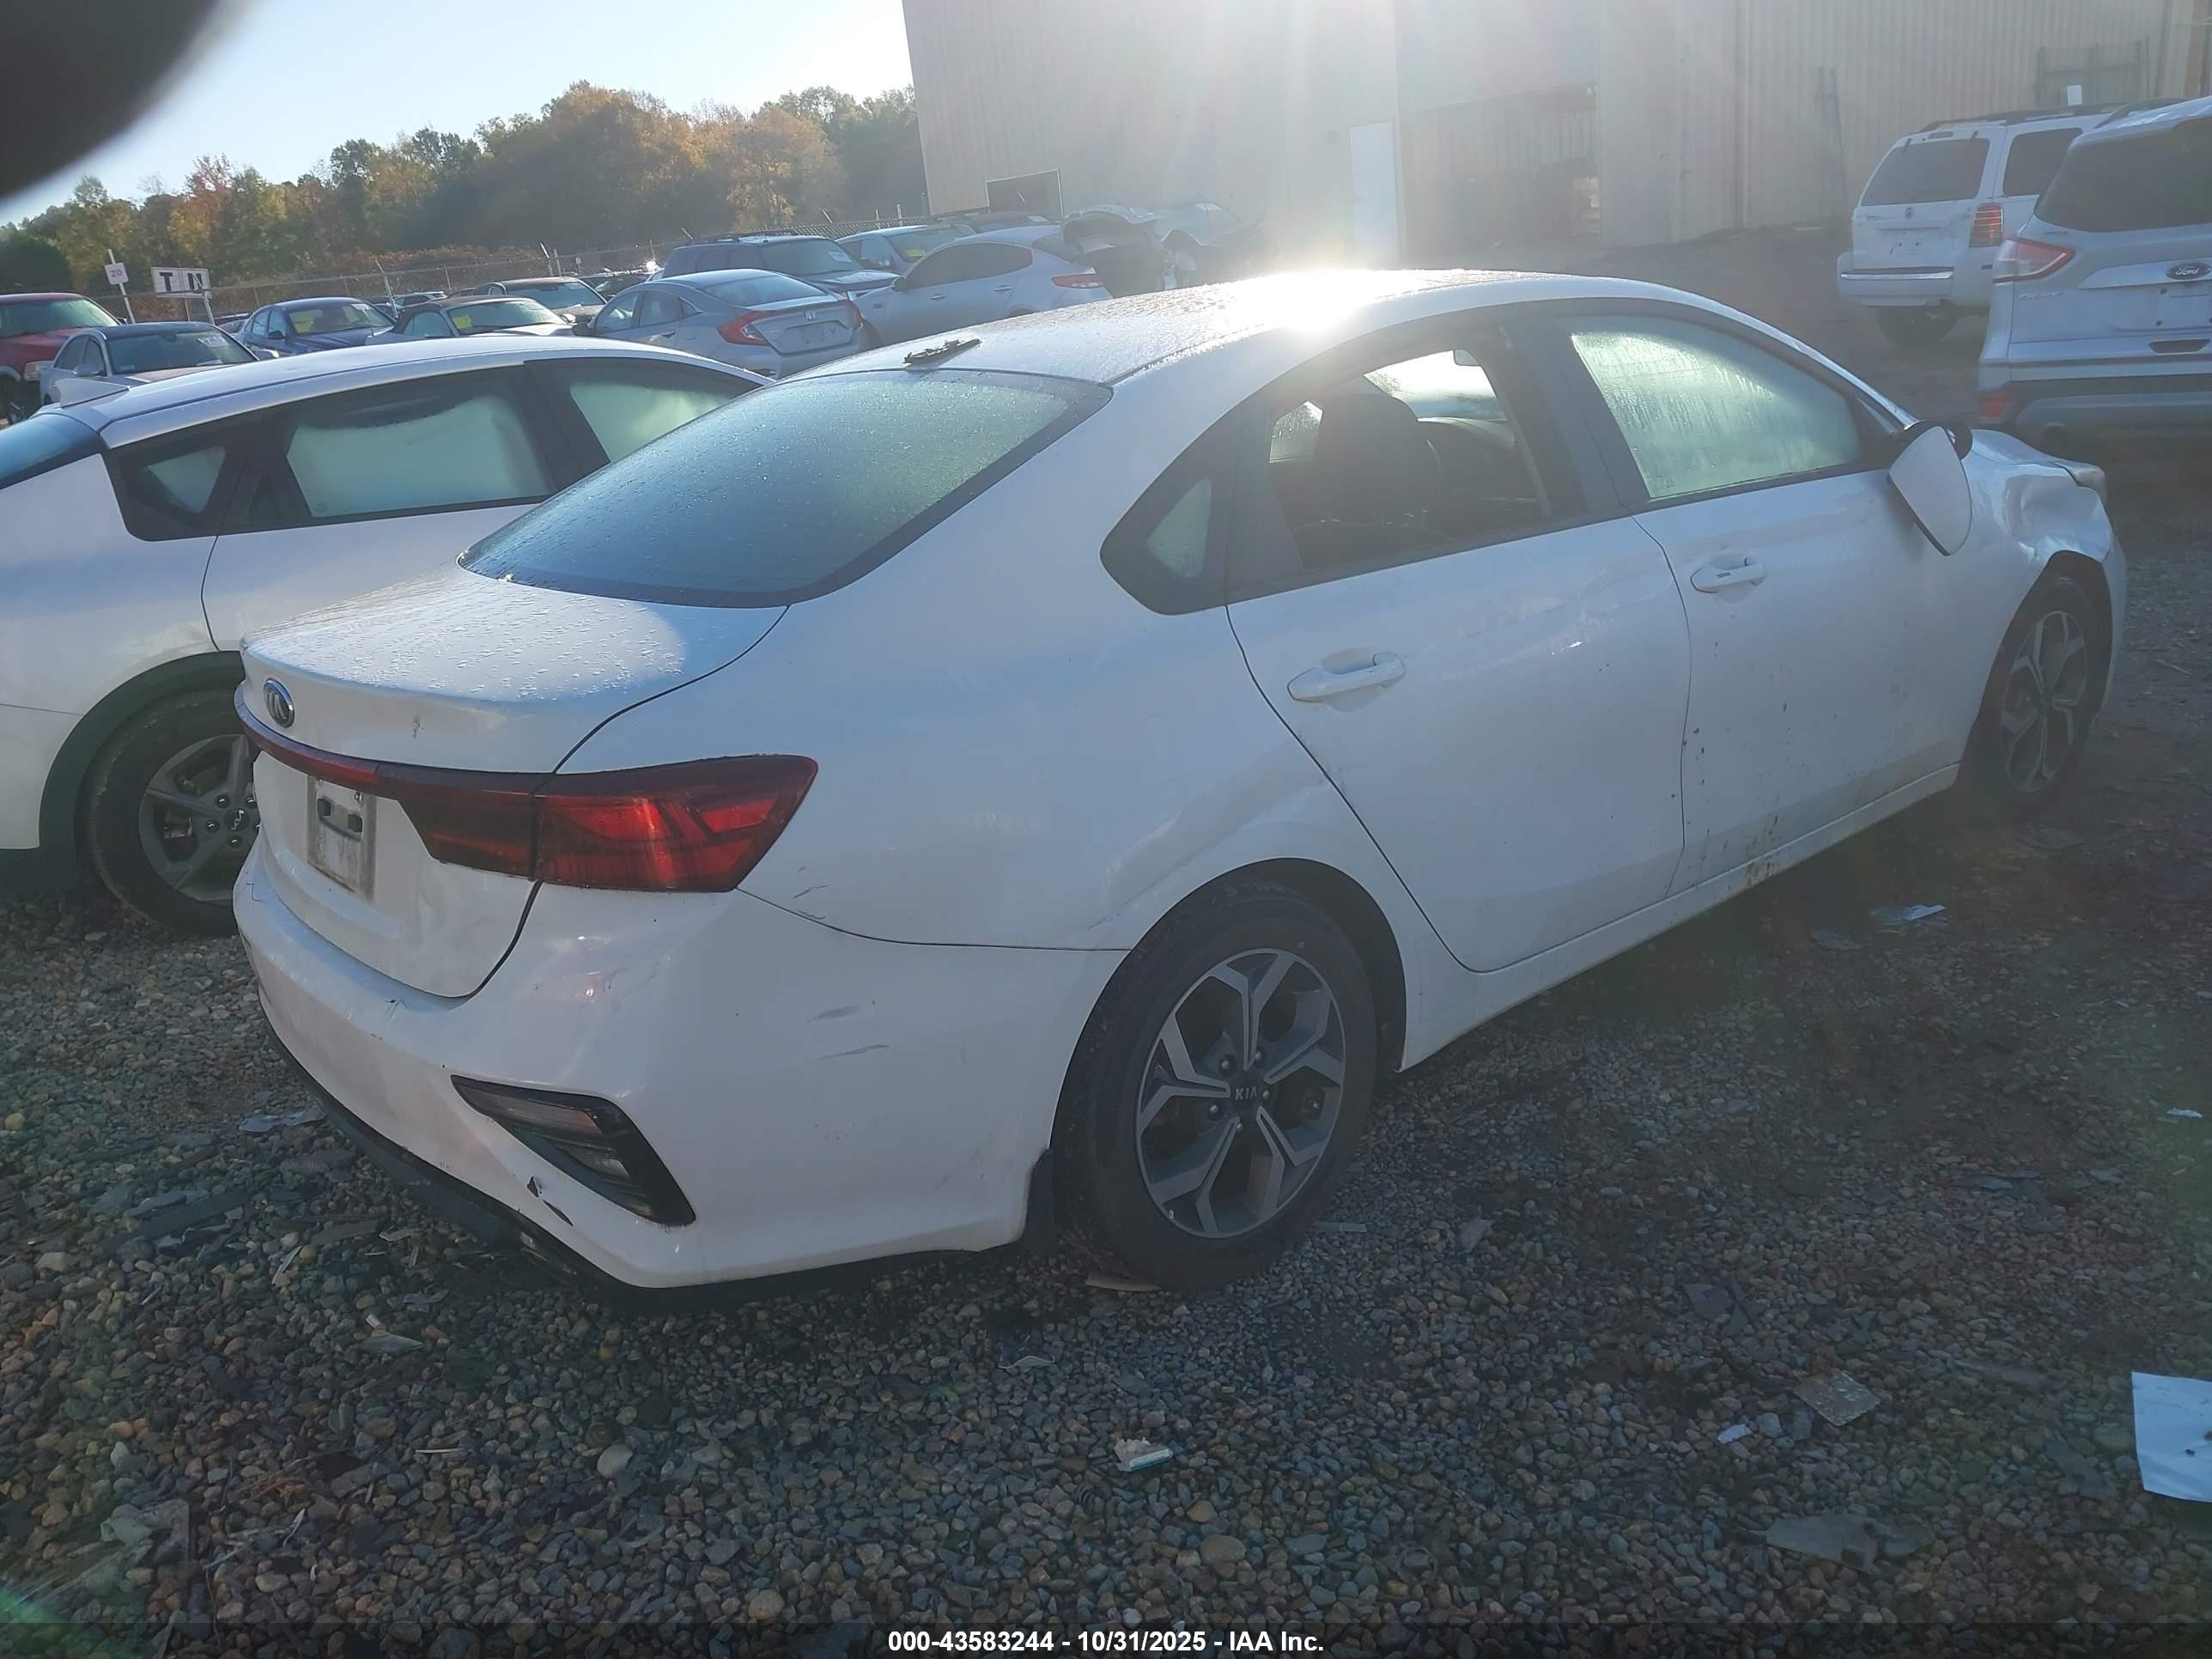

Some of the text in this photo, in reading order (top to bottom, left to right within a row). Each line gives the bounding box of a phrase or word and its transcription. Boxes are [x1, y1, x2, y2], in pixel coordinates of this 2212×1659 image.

[110, 269, 123, 277] 20
[2175, 267, 2200, 276] Ford
[159, 271, 173, 292] T
[1235, 1086, 1257, 1101] KIA
